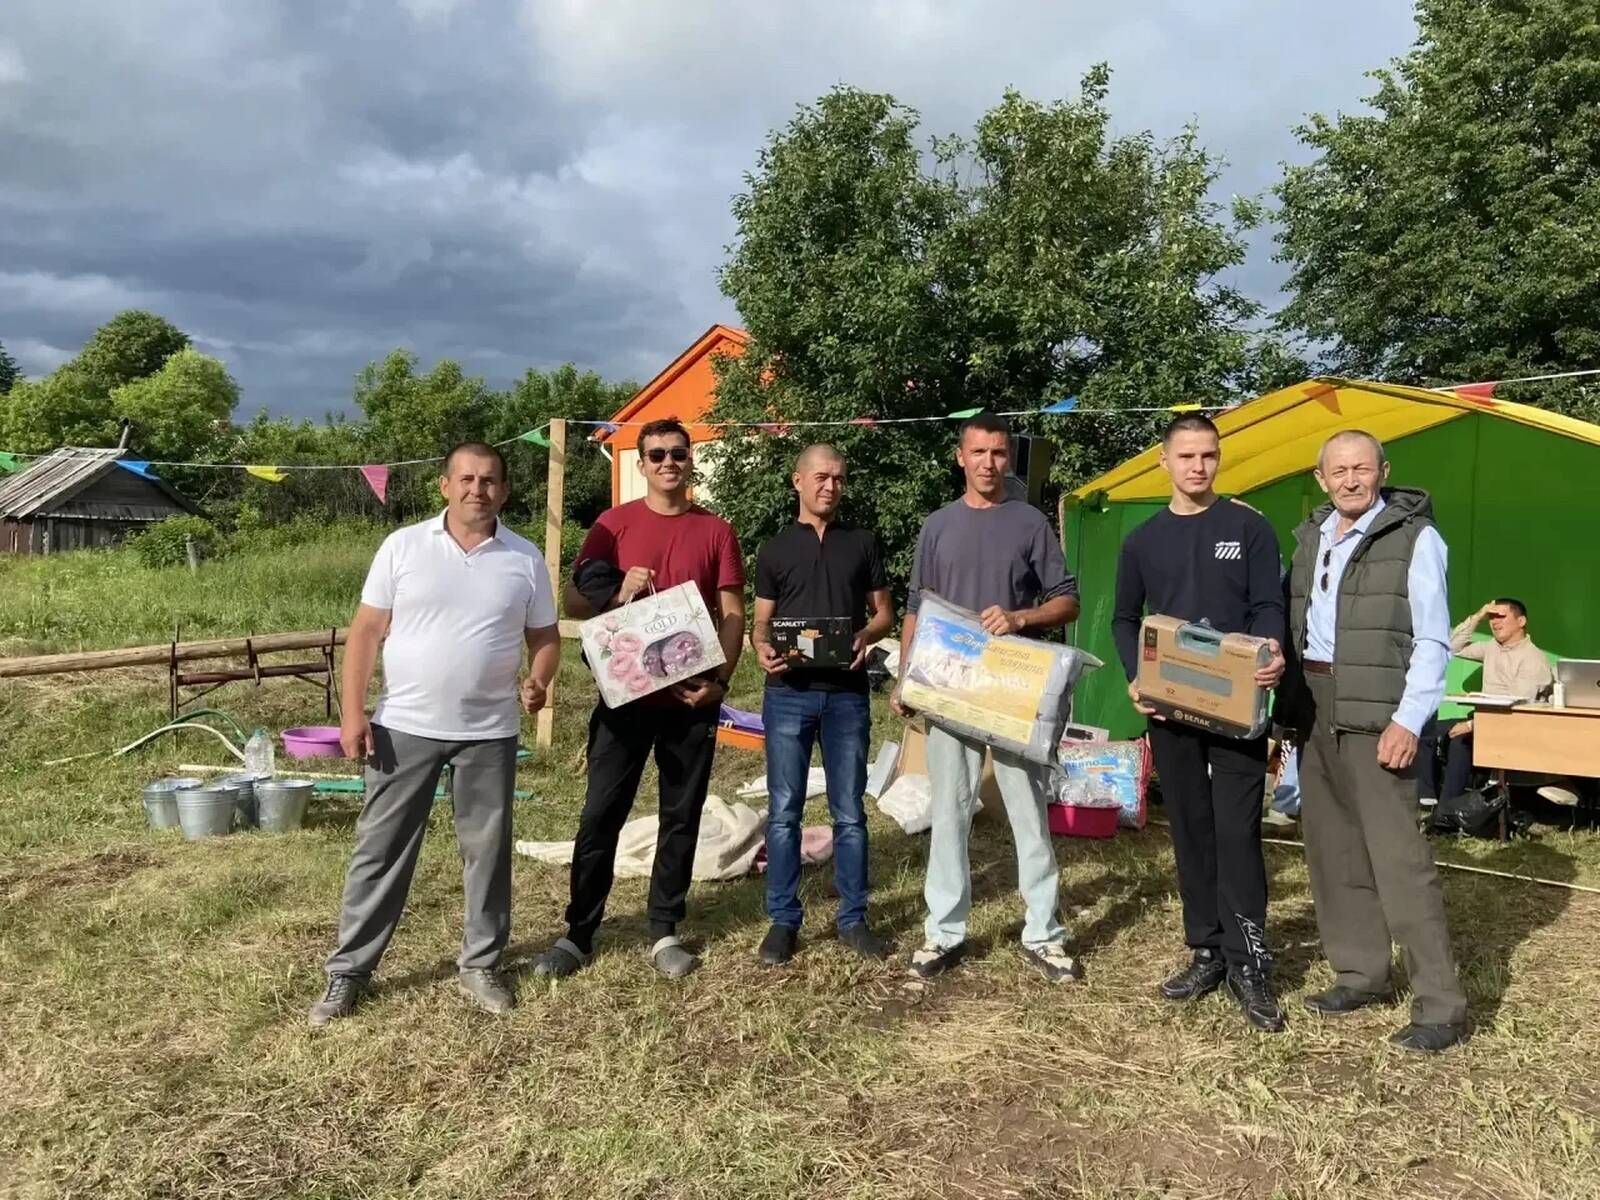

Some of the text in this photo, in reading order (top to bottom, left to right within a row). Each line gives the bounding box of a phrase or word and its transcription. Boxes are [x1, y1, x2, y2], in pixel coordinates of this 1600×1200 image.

[644, 615, 677, 634] GOLD
[772, 620, 807, 628] SCARLETT
[1184, 714, 1211, 727] БЕЛАК
